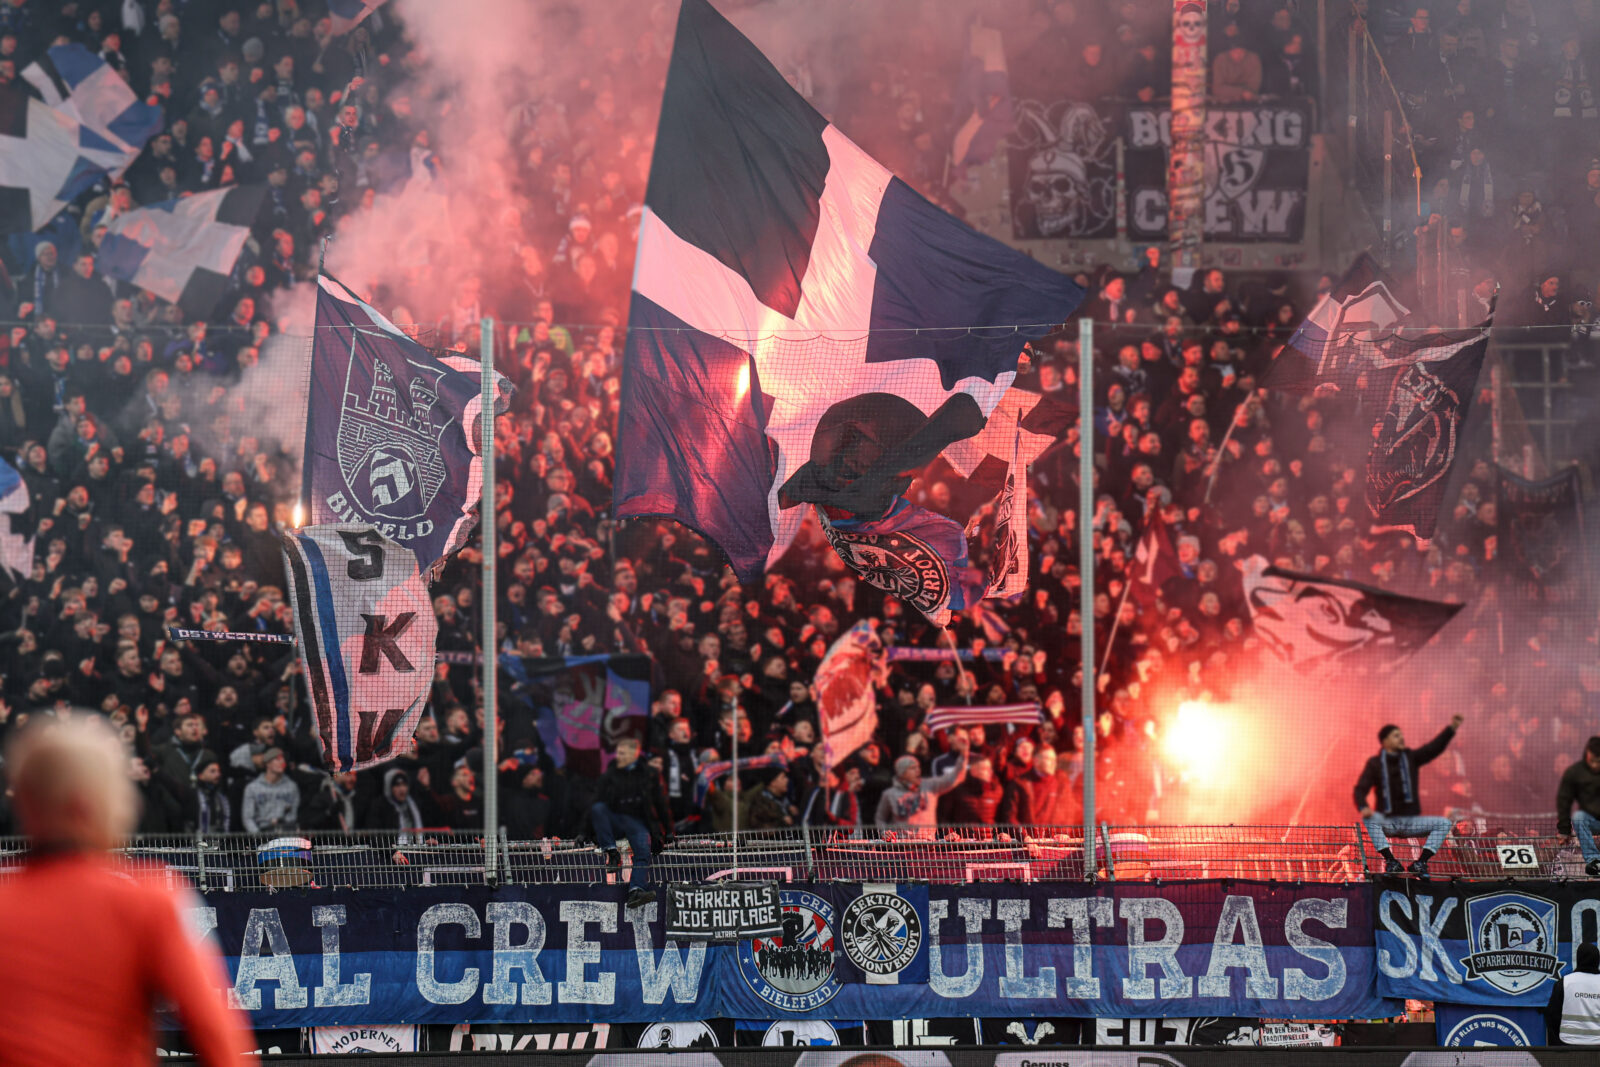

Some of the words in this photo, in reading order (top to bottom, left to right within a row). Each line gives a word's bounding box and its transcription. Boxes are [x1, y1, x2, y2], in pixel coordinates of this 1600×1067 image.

[1135, 189, 1298, 233] CEW
[1502, 848, 1533, 864] 26
[675, 889, 741, 909] STÄRKER
[744, 887, 772, 907] ALS
[852, 894, 911, 916] SEKTION
[673, 910, 709, 928] JEDE
[713, 906, 777, 927] AUFLAGE
[715, 930, 737, 939] ULTRAS
[1378, 889, 1463, 985] SK
[416, 900, 707, 1005] CREW
[844, 930, 919, 972] STADIONVERBOT
[928, 895, 1347, 1001] ULTRAS
[1475, 953, 1553, 970] SPARRENKOLLEKTIV
[760, 985, 832, 1009] BIELEFELD
[332, 1029, 402, 1053] MODERNEN
[1459, 1022, 1479, 1038] ALLES
